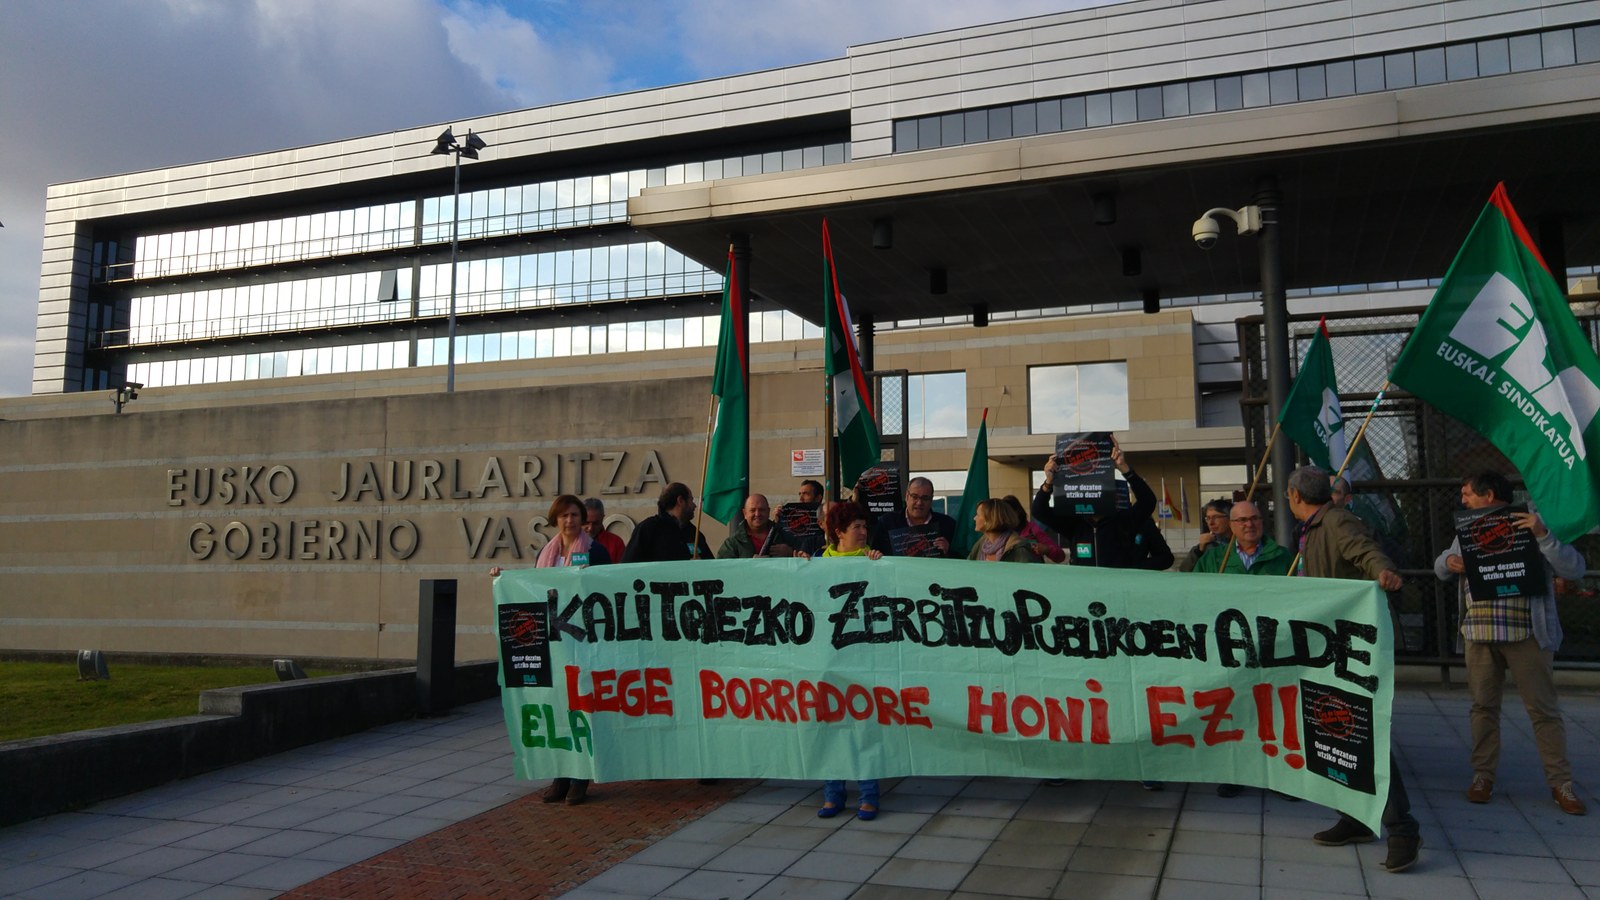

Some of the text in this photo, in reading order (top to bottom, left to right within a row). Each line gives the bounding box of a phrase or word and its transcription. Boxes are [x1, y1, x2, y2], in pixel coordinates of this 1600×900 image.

[1436, 341, 1576, 471] EUSKAL SINDIKATUA
[167, 450, 669, 507] EUSKO JAURLARITZA
[188, 513, 637, 561] GOBIERNO VASO
[1478, 562, 1525, 573] Onar dezaten
[1214, 608, 1378, 694] ALDE
[564, 665, 673, 718] LEGE
[698, 668, 933, 730] BORRADORE
[520, 703, 593, 757] ELA
[1314, 741, 1357, 763] Onar dezaten
[1337, 757, 1357, 770] duzu?
